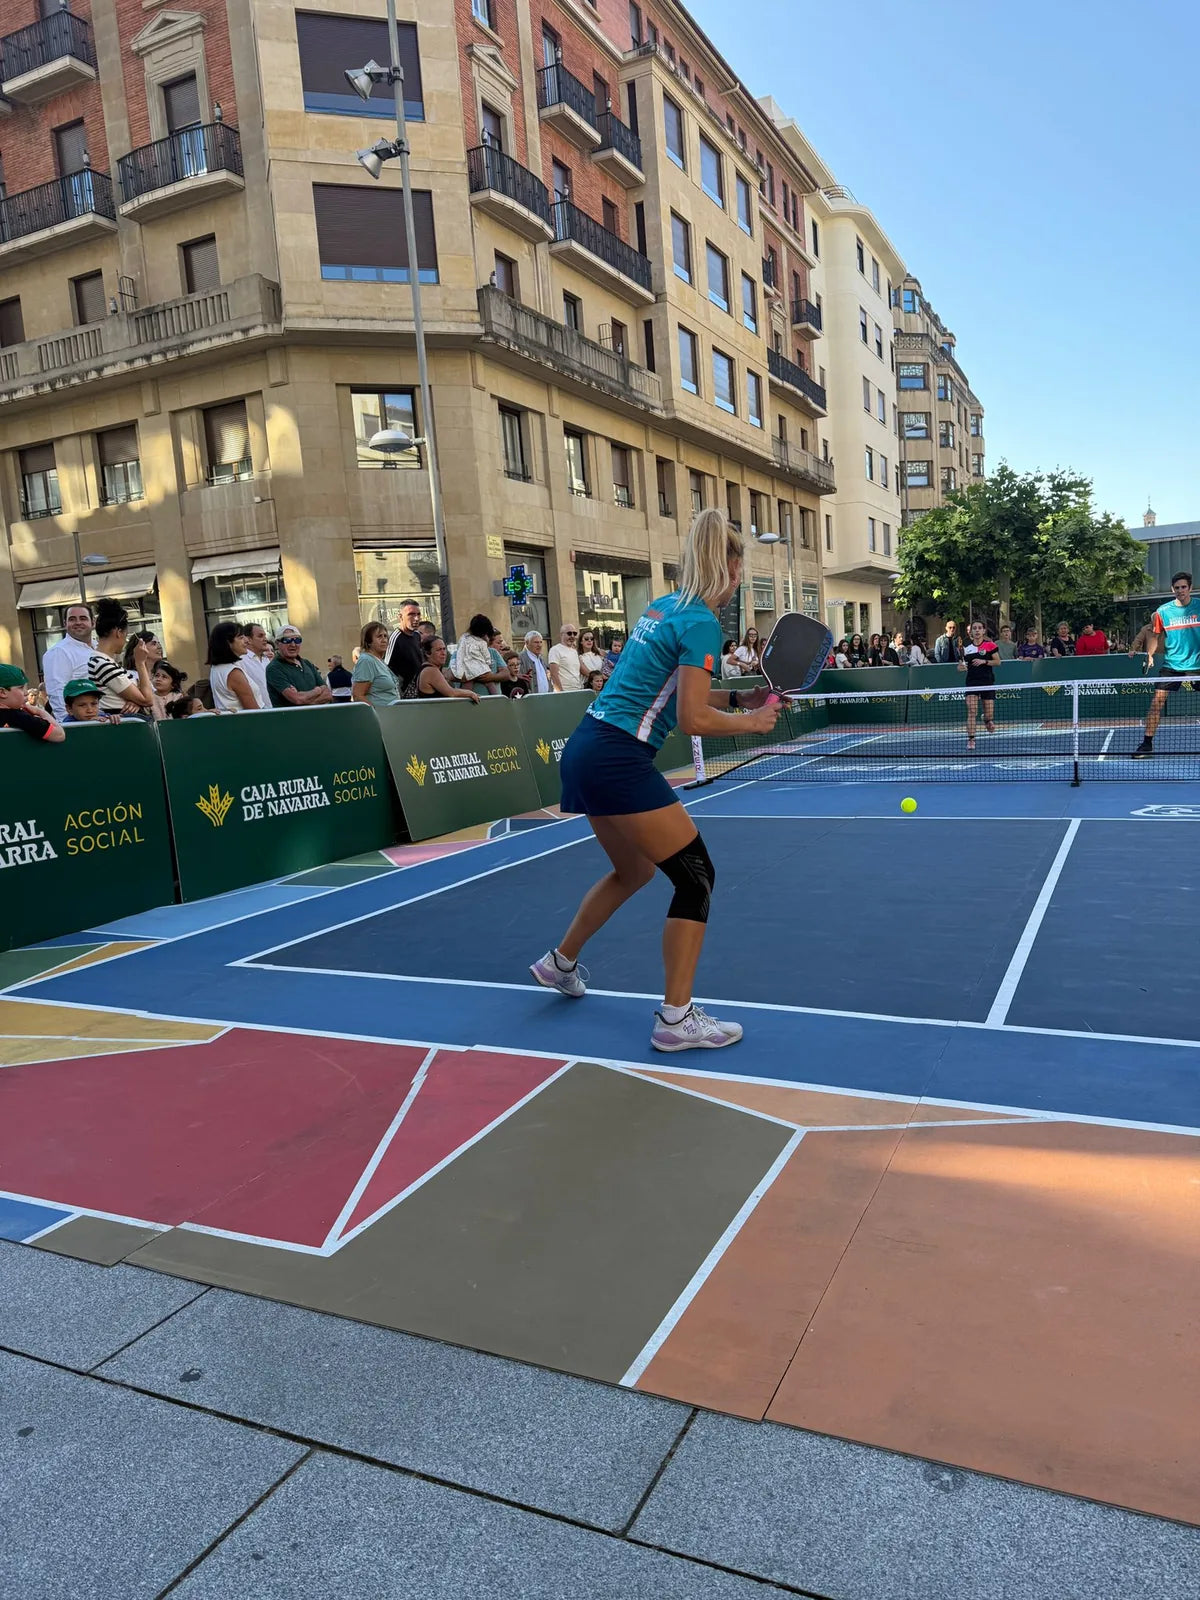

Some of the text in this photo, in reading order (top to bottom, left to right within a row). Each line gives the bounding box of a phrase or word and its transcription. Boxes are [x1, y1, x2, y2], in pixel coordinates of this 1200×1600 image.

[995, 692, 1022, 700] OCIAL
[1078, 688, 1118, 696] NAVARRA
[1121, 687, 1155, 695] SOCIAL
[429, 752, 481, 771] CAJA RURAL
[486, 745, 518, 761] ACCIÓN
[332, 765, 376, 786] ACCIÓN
[432, 764, 489, 785] DE NAVARRA
[489, 760, 521, 775] SOCIAL
[240, 775, 323, 802] CAJA RURAL
[334, 785, 378, 804] SOCIAL
[64, 802, 143, 831] ACCIÓN
[242, 791, 331, 822] DE NAVARRA
[0, 819, 45, 845] RAL
[66, 827, 145, 856] SOCIAL
